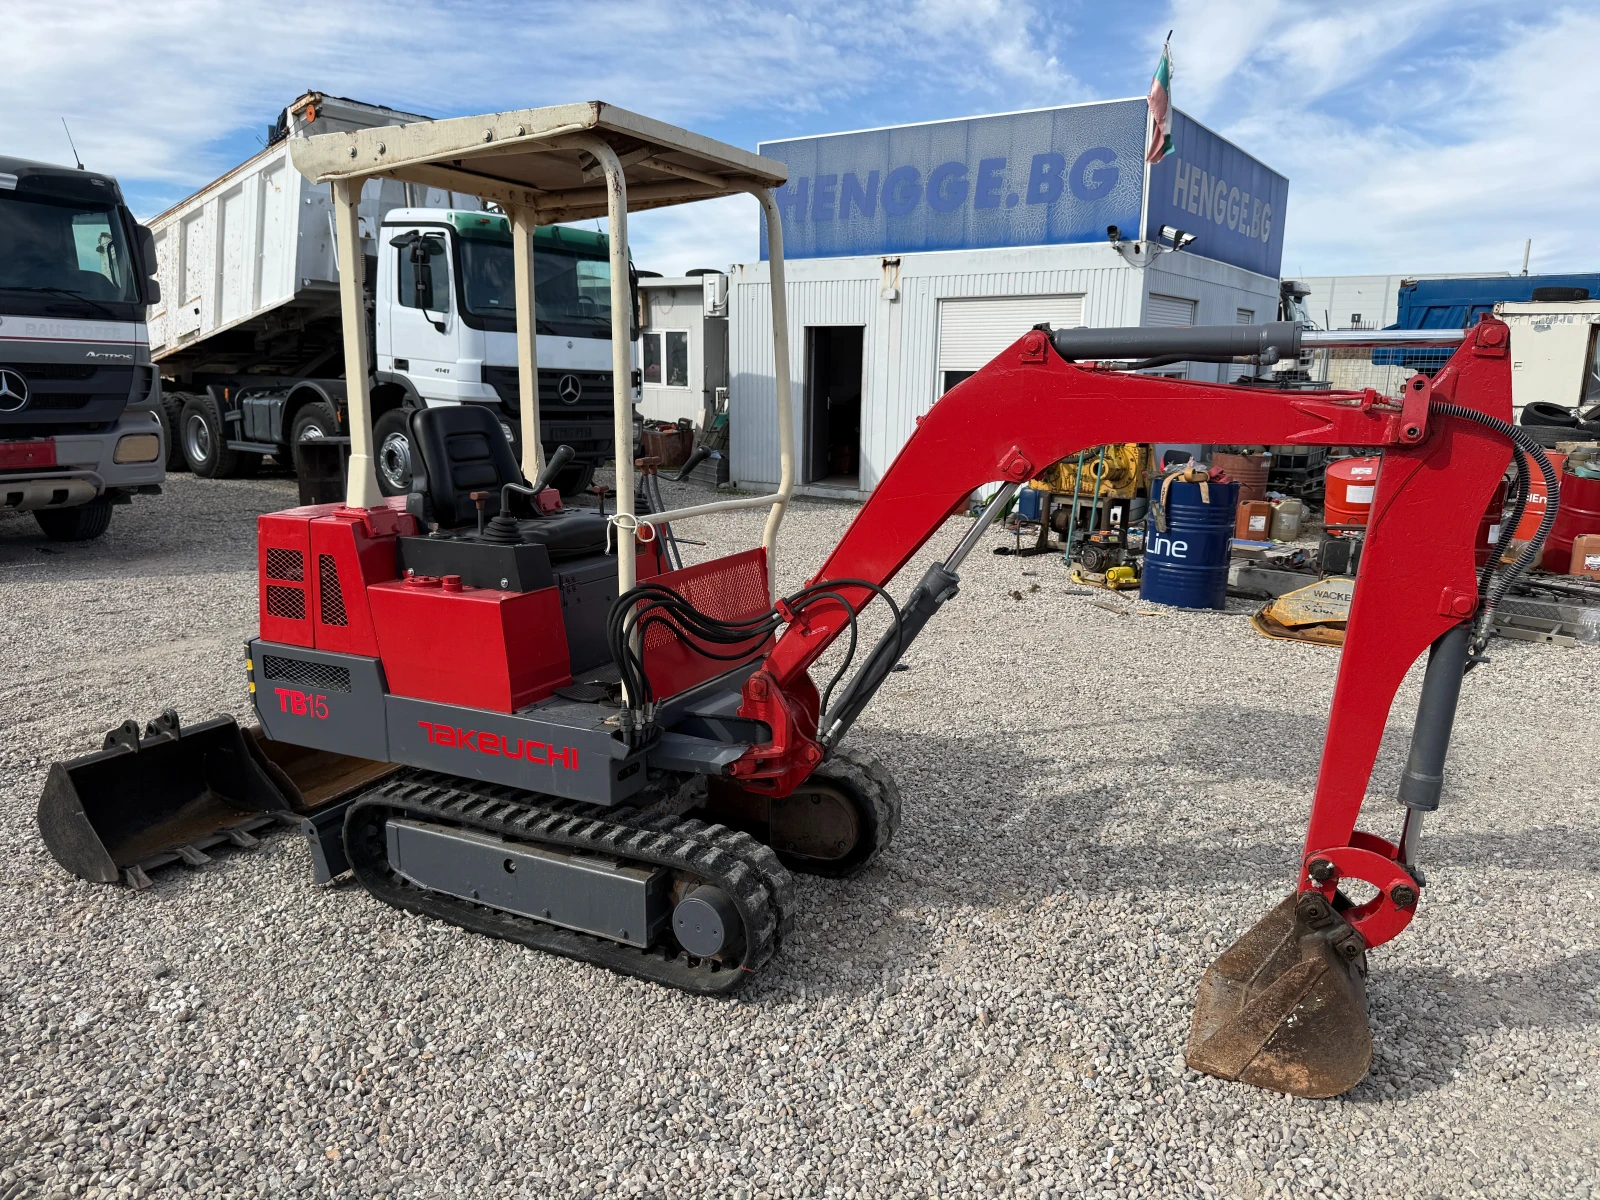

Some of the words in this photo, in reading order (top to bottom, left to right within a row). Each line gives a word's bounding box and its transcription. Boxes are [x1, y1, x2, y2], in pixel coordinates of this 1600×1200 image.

[776, 146, 1120, 223] HENGGE.BG
[1171, 157, 1273, 244] HENGGE.BG
[25, 322, 122, 339] BAUSTOFFE
[1144, 530, 1188, 559] Line
[1313, 589, 1352, 602] WACKE
[274, 687, 330, 721] TB15
